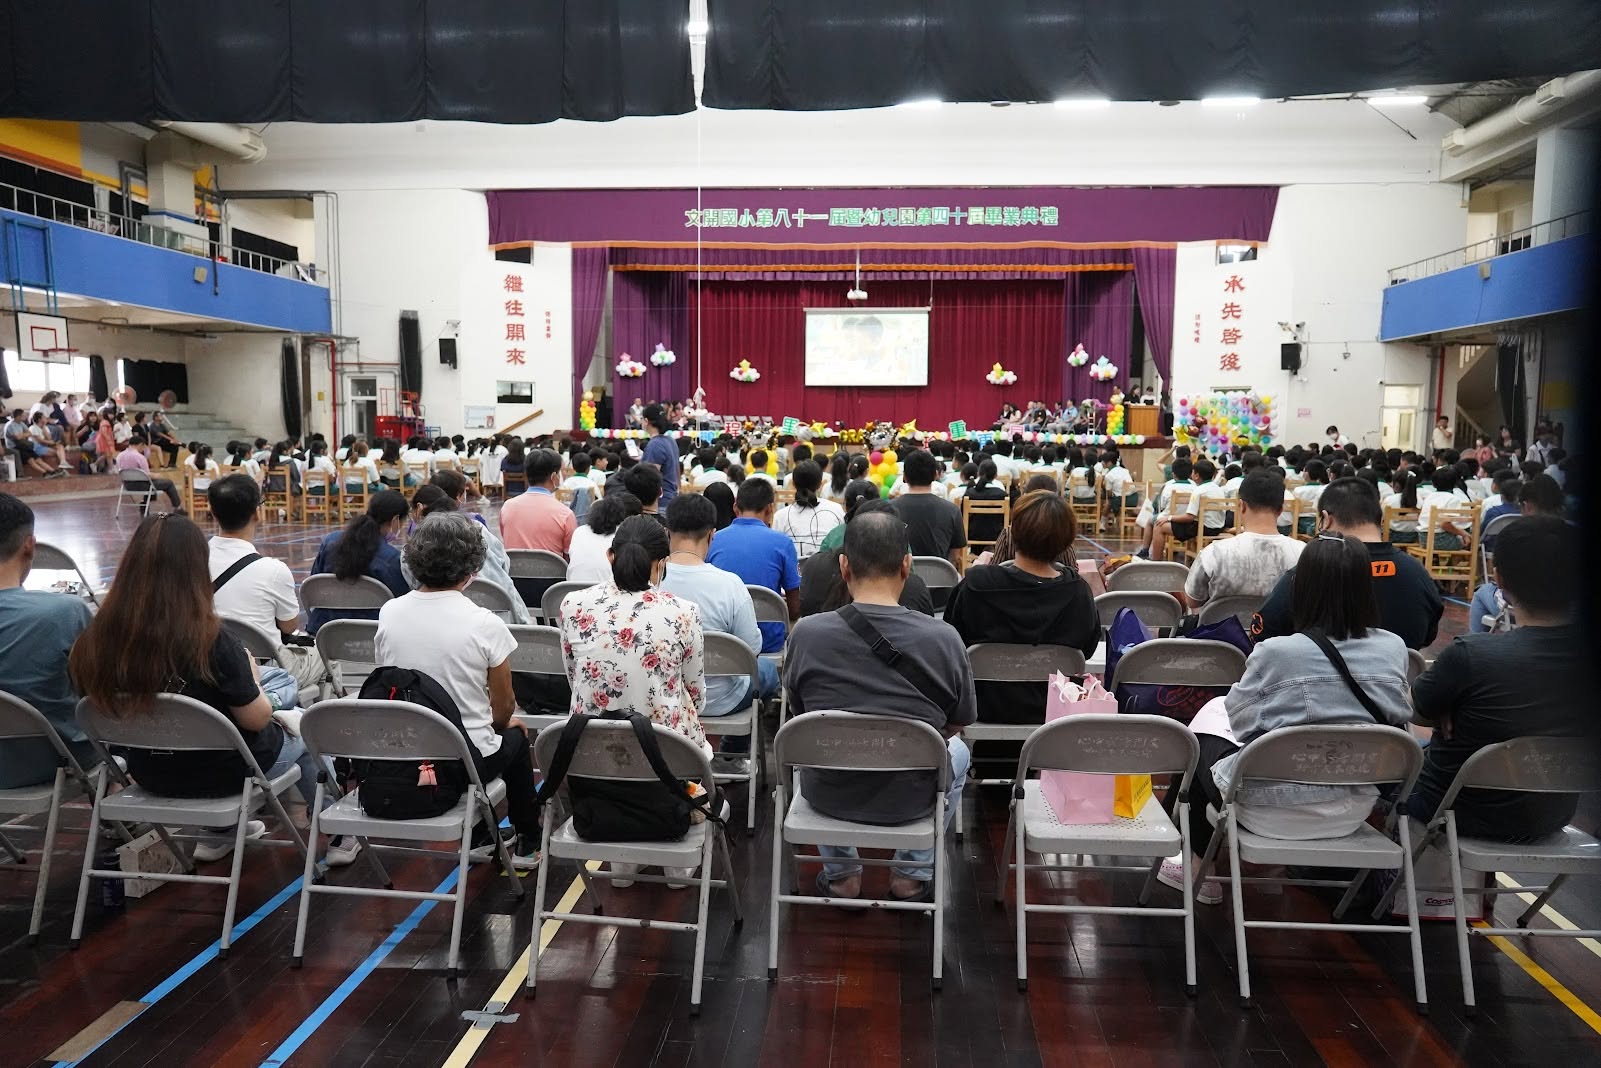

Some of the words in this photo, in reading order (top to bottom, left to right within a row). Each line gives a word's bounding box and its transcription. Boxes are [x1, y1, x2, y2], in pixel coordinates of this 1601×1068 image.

[504, 274, 526, 365] 繼往開來
[1374, 564, 1389, 574] 11
